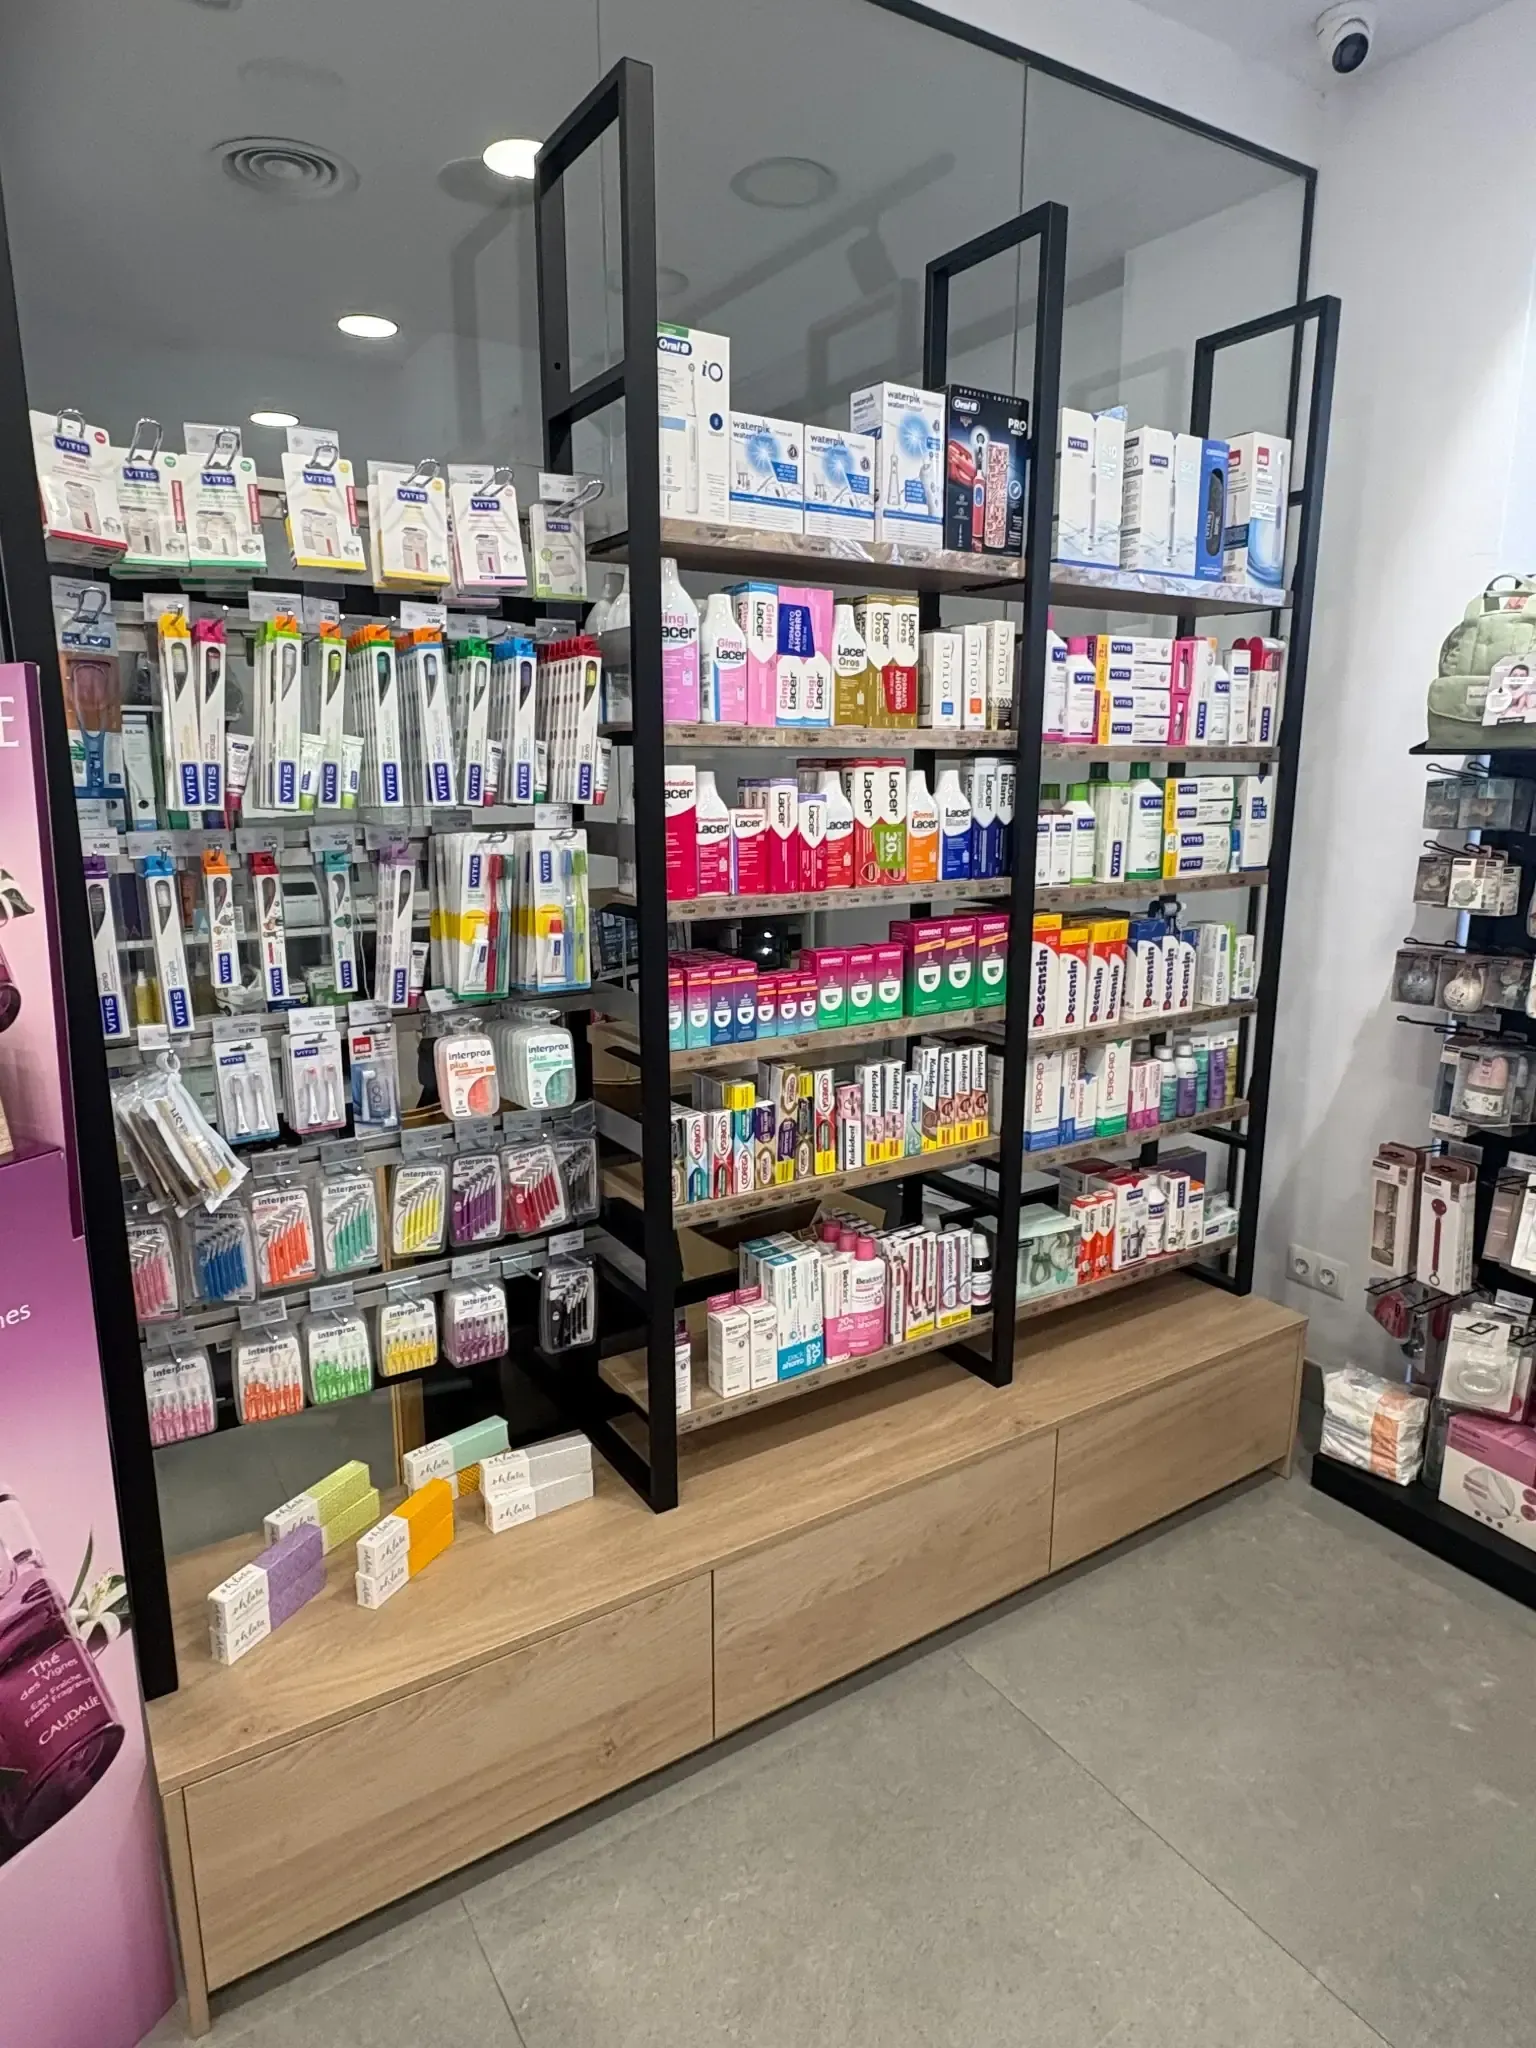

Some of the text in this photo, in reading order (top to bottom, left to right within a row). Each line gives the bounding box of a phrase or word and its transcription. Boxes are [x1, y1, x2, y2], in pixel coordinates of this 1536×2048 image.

[888, 391, 921, 404] waterpik
[733, 420, 770, 433] waterpik
[1008, 418, 1027, 431] PRO
[56, 438, 89, 455] VITIS
[811, 434, 845, 446] waterpik
[125, 469, 158, 481] VITIS
[203, 474, 234, 486] VITIS
[304, 472, 334, 485] VITIS
[399, 489, 427, 502] VITIS
[472, 501, 499, 511] VITIS
[548, 522, 571, 532] VITIS
[662, 627, 697, 639] acer
[756, 601, 764, 642] Lacer
[765, 604, 774, 638] Gingi
[883, 612, 891, 650] Lacer
[908, 613, 917, 651] Lacer
[716, 647, 746, 660] Lacer
[717, 638, 742, 649] Gingi
[838, 645, 865, 657] Lacer
[1113, 643, 1132, 653] VITIS
[839, 657, 860, 667] Oros
[942, 645, 950, 698] YOTUEL
[970, 643, 978, 695] YOTUEL
[998, 632, 1006, 685] YOTUEL
[1111, 669, 1130, 678] VITIS
[780, 675, 789, 709] Gingi
[788, 673, 798, 710] Lacer
[806, 675, 816, 709] Gingi
[814, 673, 824, 710] Lacer
[1115, 698, 1132, 707] VITIS
[1112, 724, 1131, 732] VITIS
[184, 766, 197, 802] VITIS
[207, 765, 217, 802] VITIS
[283, 764, 293, 800] VITIS
[326, 764, 335, 800] VITIS
[385, 764, 395, 800] VITIS
[437, 765, 447, 799] VITIS
[470, 766, 481, 798] VITIS
[519, 765, 528, 797] VITIS
[581, 765, 589, 797] VITIS
[863, 771, 875, 817] Lacer
[889, 771, 900, 816] Lacer
[985, 773, 994, 811] Lacer
[1000, 773, 1008, 808] Blanc
[1008, 773, 1016, 810] Lacer
[1179, 785, 1197, 793] VITIS
[735, 817, 763, 828] Lacer
[808, 804, 816, 838] Lacer
[827, 820, 853, 829] Lacer
[911, 818, 938, 829] Lacer
[913, 811, 934, 819] Sensi
[945, 807, 971, 818] Lacer
[945, 818, 968, 827] Blanc
[1178, 808, 1196, 816] VITIS
[696, 822, 729, 834] Lacer
[1182, 835, 1203, 844] VITIS
[471, 856, 479, 886] VITIS
[542, 852, 550, 881] VITIS
[1112, 843, 1120, 876] VITIS
[1181, 859, 1202, 868] VITIS
[221, 954, 229, 981] VITIS
[342, 961, 351, 987] VITIS
[1237, 945, 1246, 977] xeros
[102, 972, 110, 991] perio
[272, 970, 281, 994] VITIS
[395, 971, 405, 1003] VITIS
[1033, 949, 1048, 1027] Desensin
[1143, 946, 1155, 1008] Desensin
[1163, 947, 1175, 1011] Desensin
[1179, 951, 1191, 1008] Desensin
[1215, 971, 1223, 1003] xeros
[1065, 959, 1077, 1024] Desensin
[1089, 966, 1103, 1022] Desensin
[1106, 964, 1119, 1020] Desensin
[104, 997, 117, 1032] VITIS
[173, 991, 185, 1025] VITIS
[448, 1049, 491, 1062] interprox
[528, 1043, 569, 1056] interprox
[529, 1054, 547, 1063] plus
[450, 1061, 469, 1071] plus
[927, 1057, 936, 1098] Kukident
[458, 1157, 493, 1167] interprox
[513, 1147, 546, 1161] interprox
[741, 1154, 749, 1185] COREGA
[128, 1226, 157, 1238] erprox
[462, 1294, 497, 1307] interprox
[318, 1325, 356, 1340] interprox
[726, 1322, 747, 1332] Bexident
[753, 1315, 775, 1325] Bexident
[248, 1342, 288, 1356] interprox
[152, 1362, 197, 1378] interprox
[27, 1652, 61, 1677] Thé
[20, 1657, 79, 1701] des Vignes
[24, 1676, 92, 1728] Fresh Fragrance
[30, 1673, 82, 1712] Eau Fraîche
